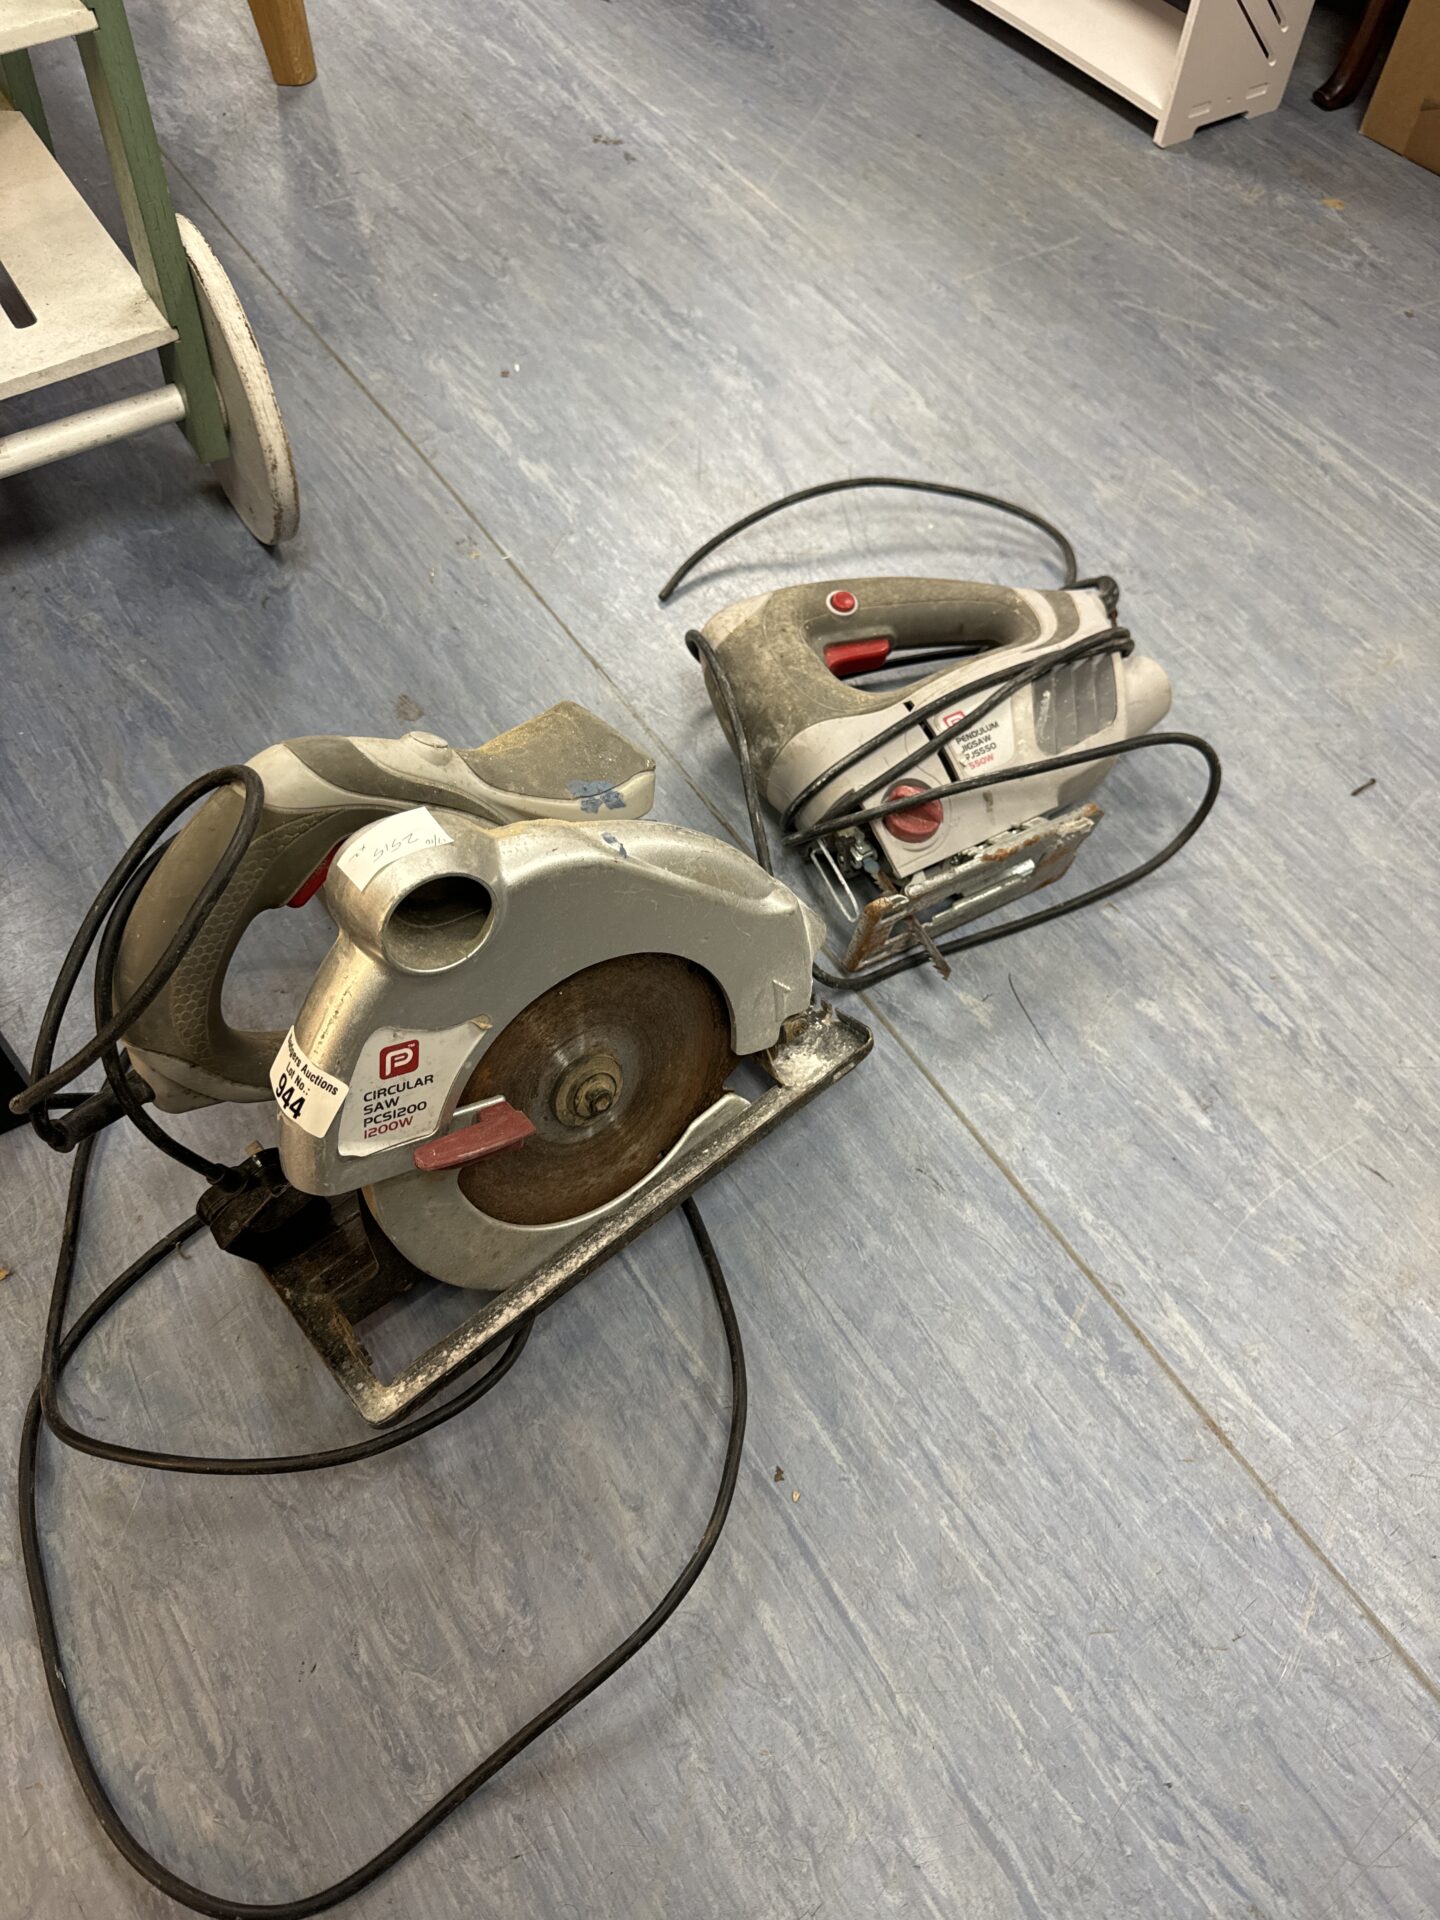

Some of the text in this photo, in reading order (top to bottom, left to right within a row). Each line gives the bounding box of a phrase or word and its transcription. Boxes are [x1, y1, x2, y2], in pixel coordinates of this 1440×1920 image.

[955, 721, 999, 745] PENDULUM
[961, 735, 992, 753] JIGSAW
[969, 754, 994, 769] 550W
[286, 1061, 296, 1079] Lot
[300, 1063, 339, 1096] Auctions
[276, 1072, 306, 1119] 944
[363, 1074, 434, 1102] CIRCULAR
[363, 1096, 400, 1116] SAW
[363, 1101, 427, 1128] PCS1200
[363, 1115, 413, 1140] 1200W
